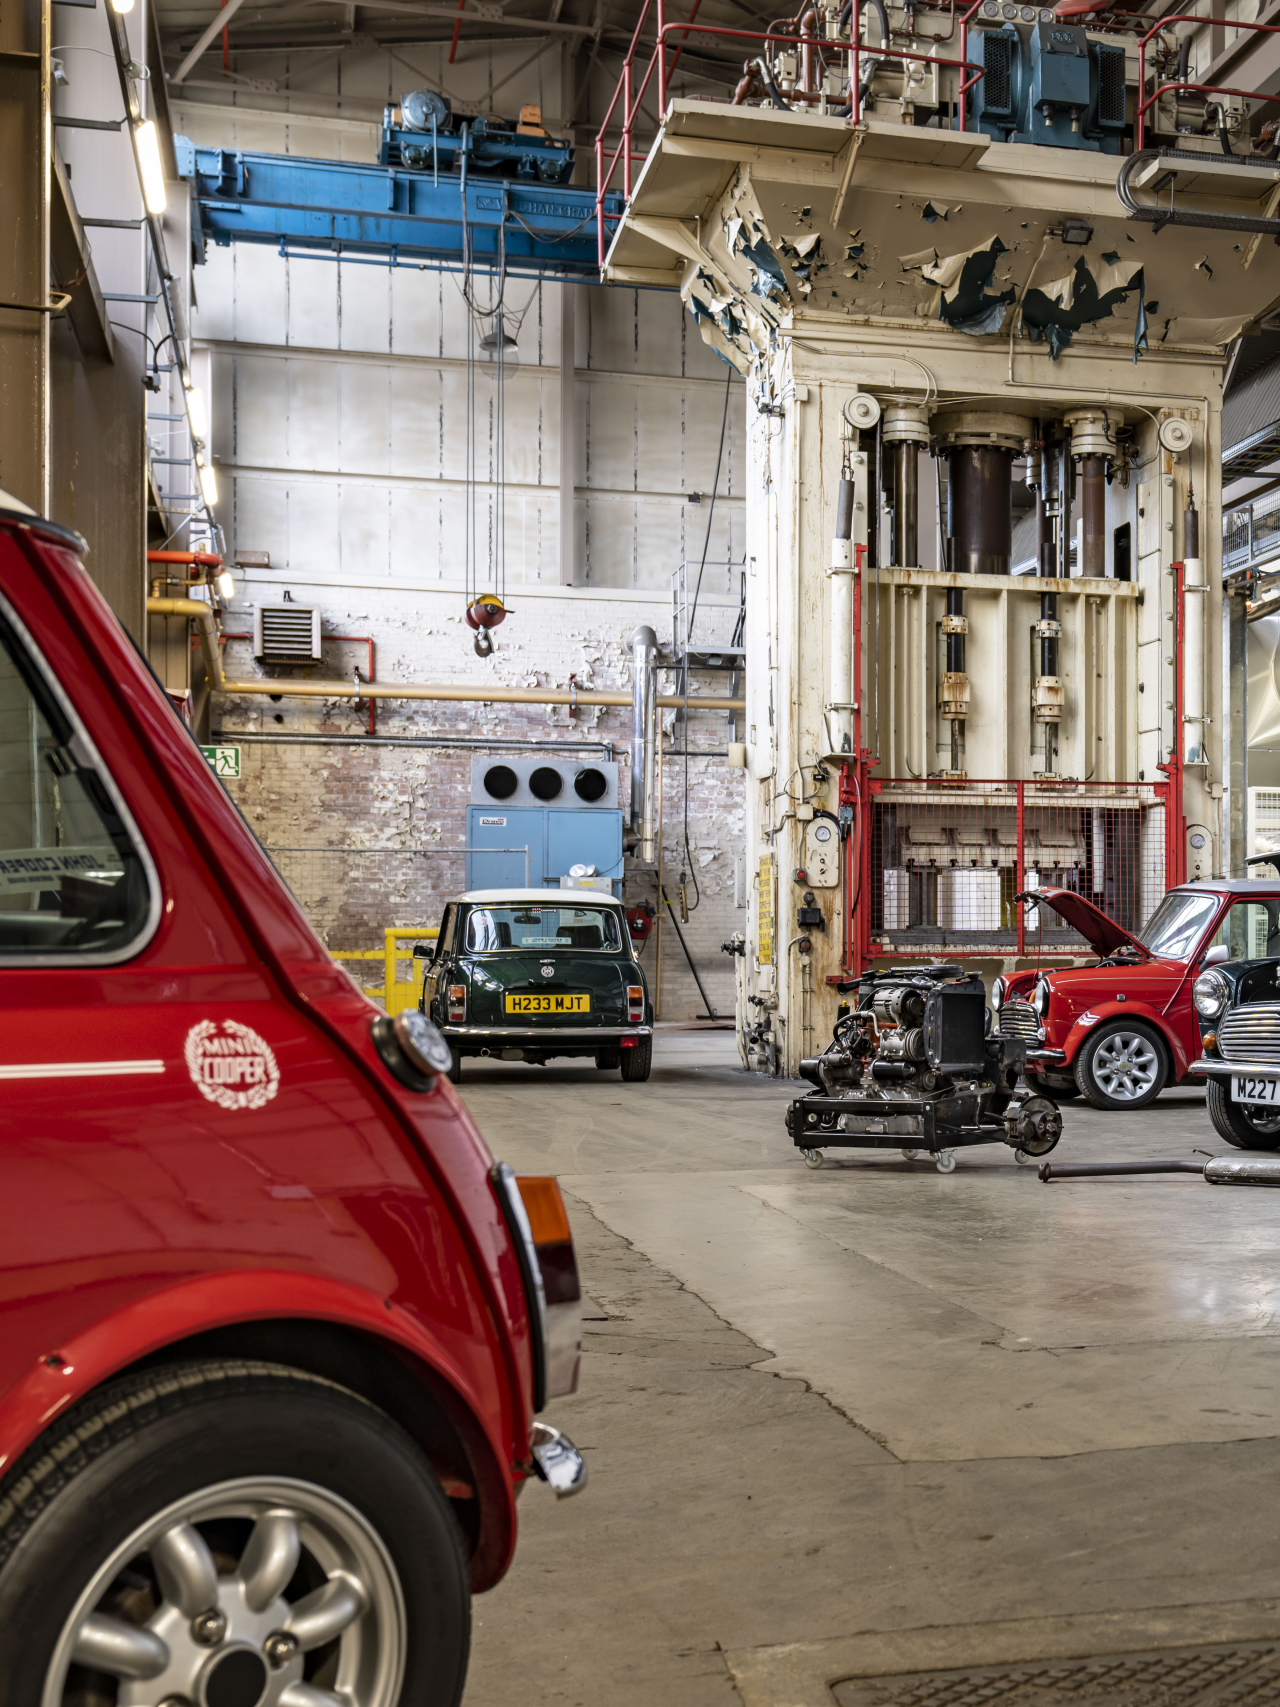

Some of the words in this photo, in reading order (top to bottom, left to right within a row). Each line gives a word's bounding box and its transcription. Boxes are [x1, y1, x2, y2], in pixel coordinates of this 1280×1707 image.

[560, 206, 598, 218] CRAN
[513, 998, 551, 1011] H233
[555, 997, 583, 1010] MJT
[201, 1037, 253, 1055] MINI
[203, 1057, 267, 1083] COOPER
[1238, 1077, 1277, 1100] M227
